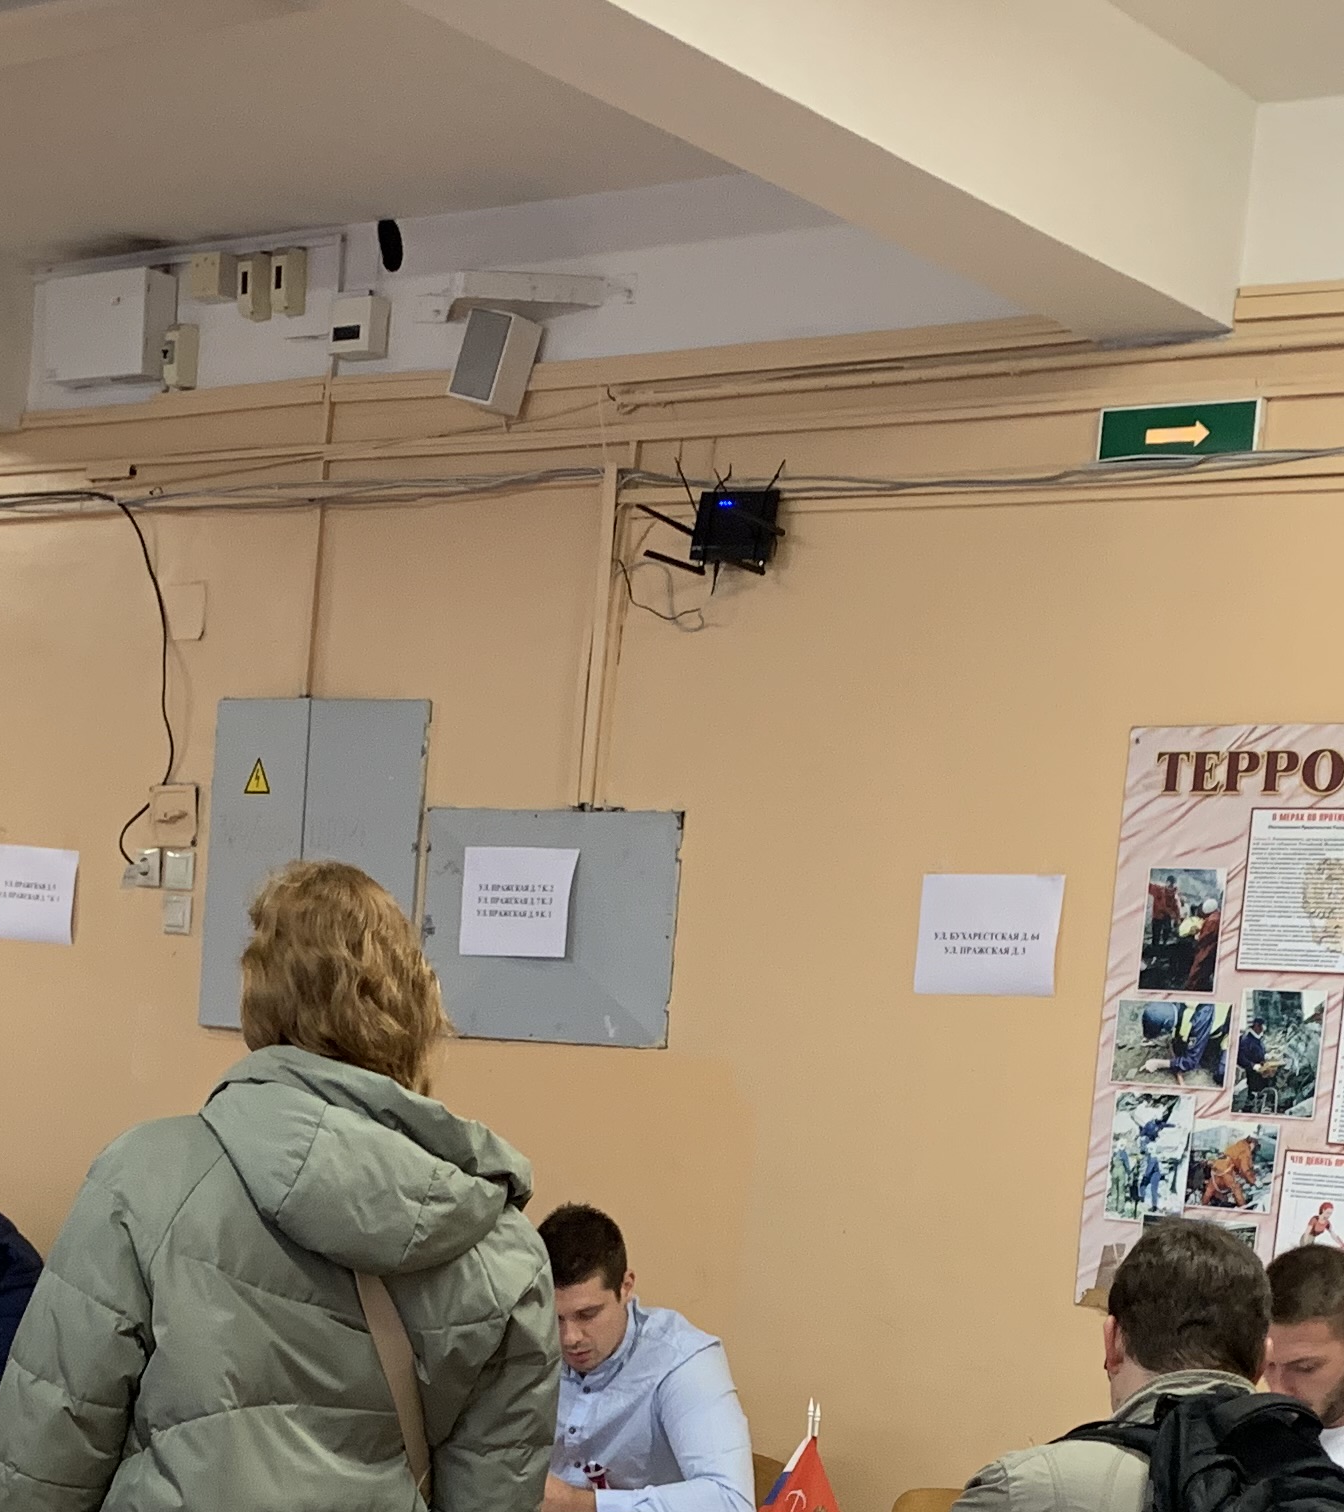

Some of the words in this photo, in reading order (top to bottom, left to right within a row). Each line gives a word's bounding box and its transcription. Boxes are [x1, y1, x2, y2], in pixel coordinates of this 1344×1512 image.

[1279, 813, 1305, 822] МЕРАХ
[949, 932, 1019, 941] БУХАРЕСТСКАЯ
[1030, 933, 1040, 941] 64
[960, 946, 1010, 955] ПРАЖСКАЯ
